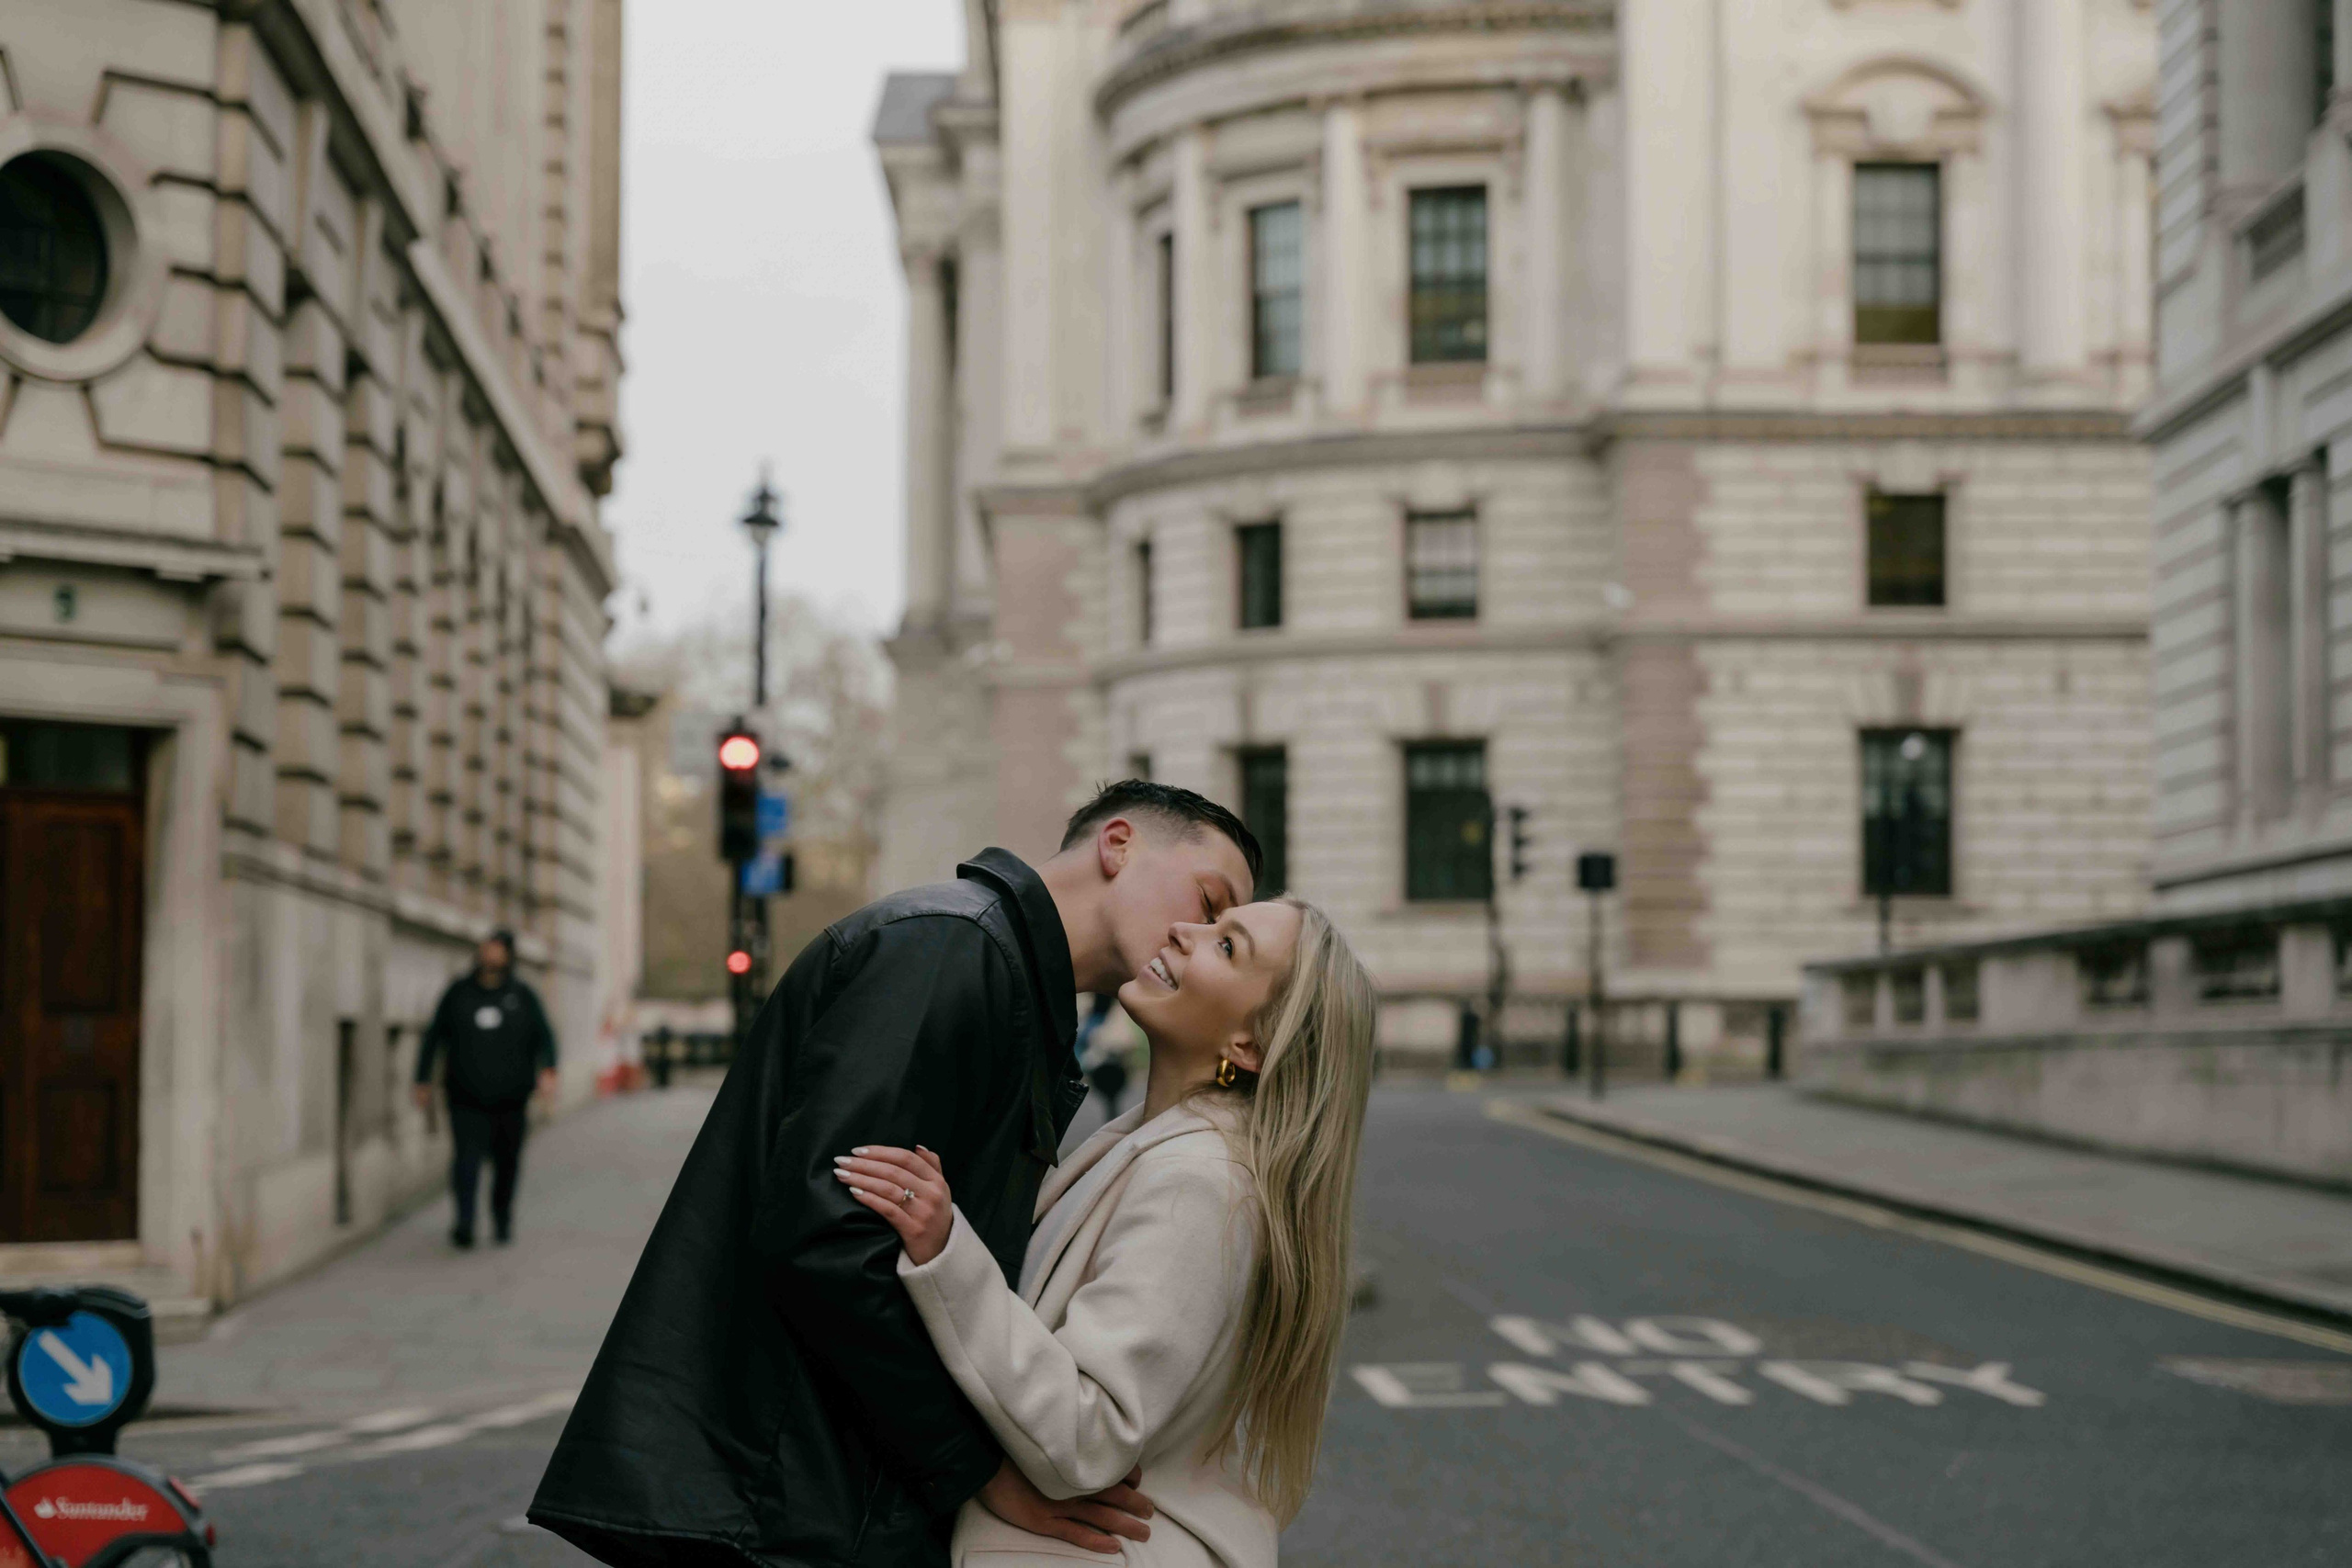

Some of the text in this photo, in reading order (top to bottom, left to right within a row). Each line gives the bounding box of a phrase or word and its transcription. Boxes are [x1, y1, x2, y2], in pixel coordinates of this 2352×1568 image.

[1490, 1314, 1762, 1358] NO
[1351, 1361, 2046, 1406] ENTRY
[55, 1496, 149, 1521] Santander
